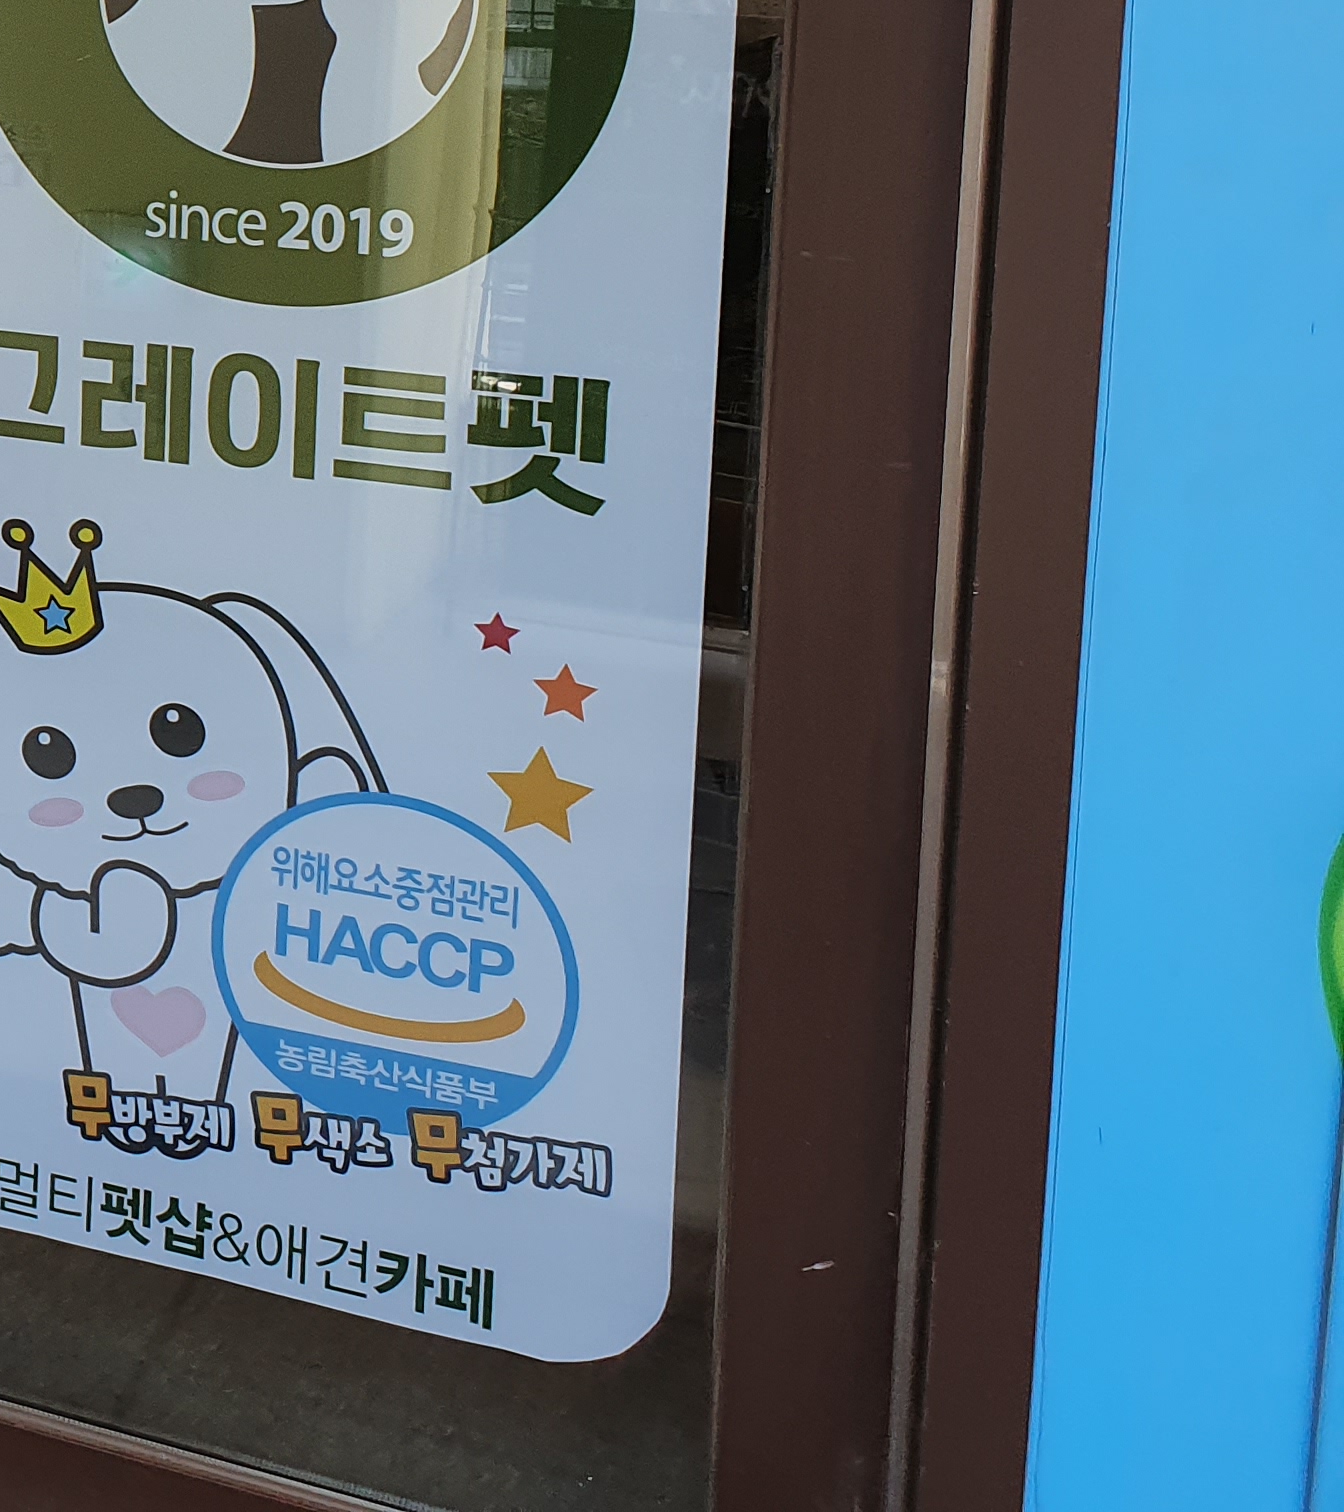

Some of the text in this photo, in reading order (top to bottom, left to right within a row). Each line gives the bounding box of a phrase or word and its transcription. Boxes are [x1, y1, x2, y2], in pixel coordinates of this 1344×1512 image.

[144, 190, 414, 259] since 2019
[270, 845, 521, 931] 위해요소중점관리
[274, 903, 514, 995] HACCP
[273, 1038, 499, 1111] 농림축산식품부
[62, 1070, 612, 1197] 무방부제 무색소 무첨가제
